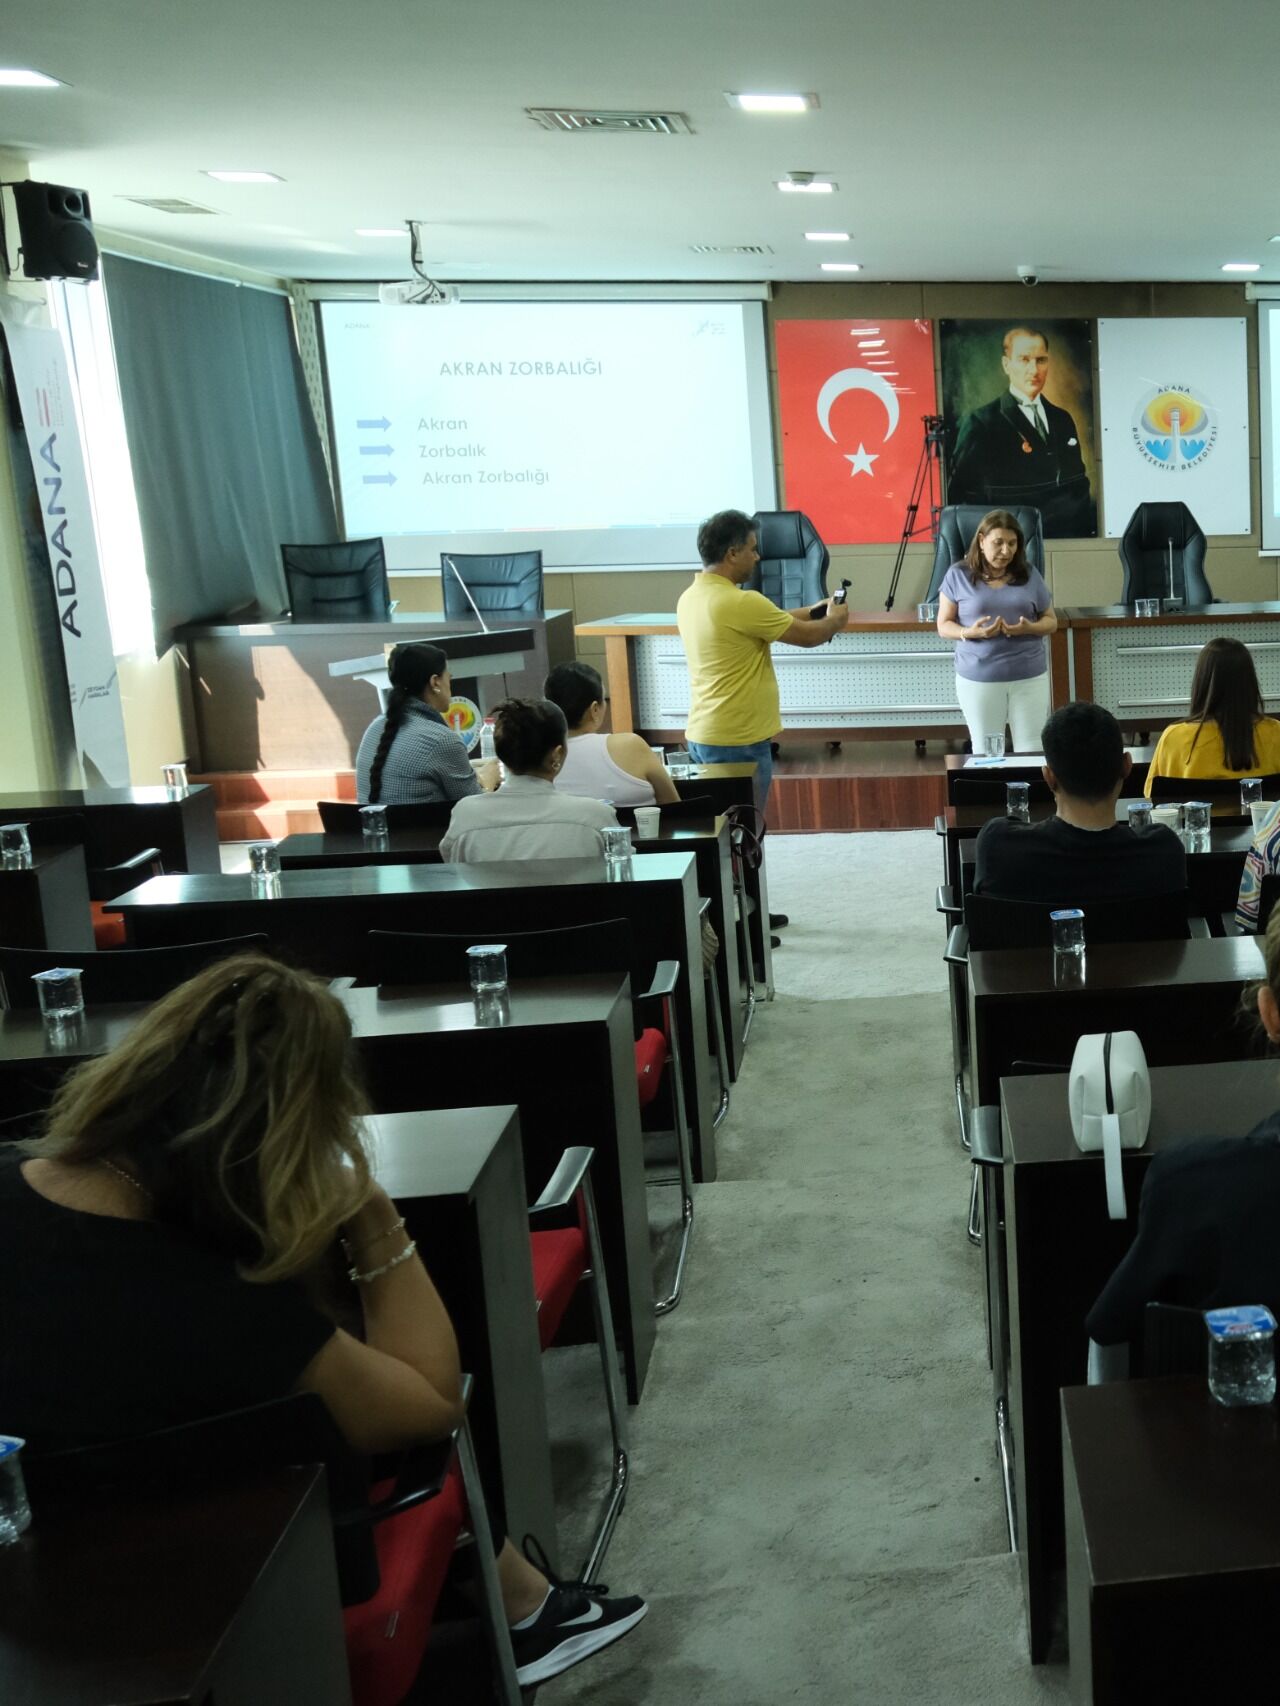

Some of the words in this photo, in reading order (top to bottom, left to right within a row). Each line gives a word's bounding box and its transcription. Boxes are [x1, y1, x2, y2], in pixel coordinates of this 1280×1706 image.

[440, 361, 502, 376] AKRAN
[509, 358, 602, 376] ZORBALIĞI
[1158, 385, 1190, 394] ADANA
[418, 417, 468, 431] Akran
[419, 443, 486, 458] Zorbalık
[423, 471, 472, 485] Akran
[477, 468, 549, 485] Zorbalığı
[40, 432, 82, 638] ADANA
